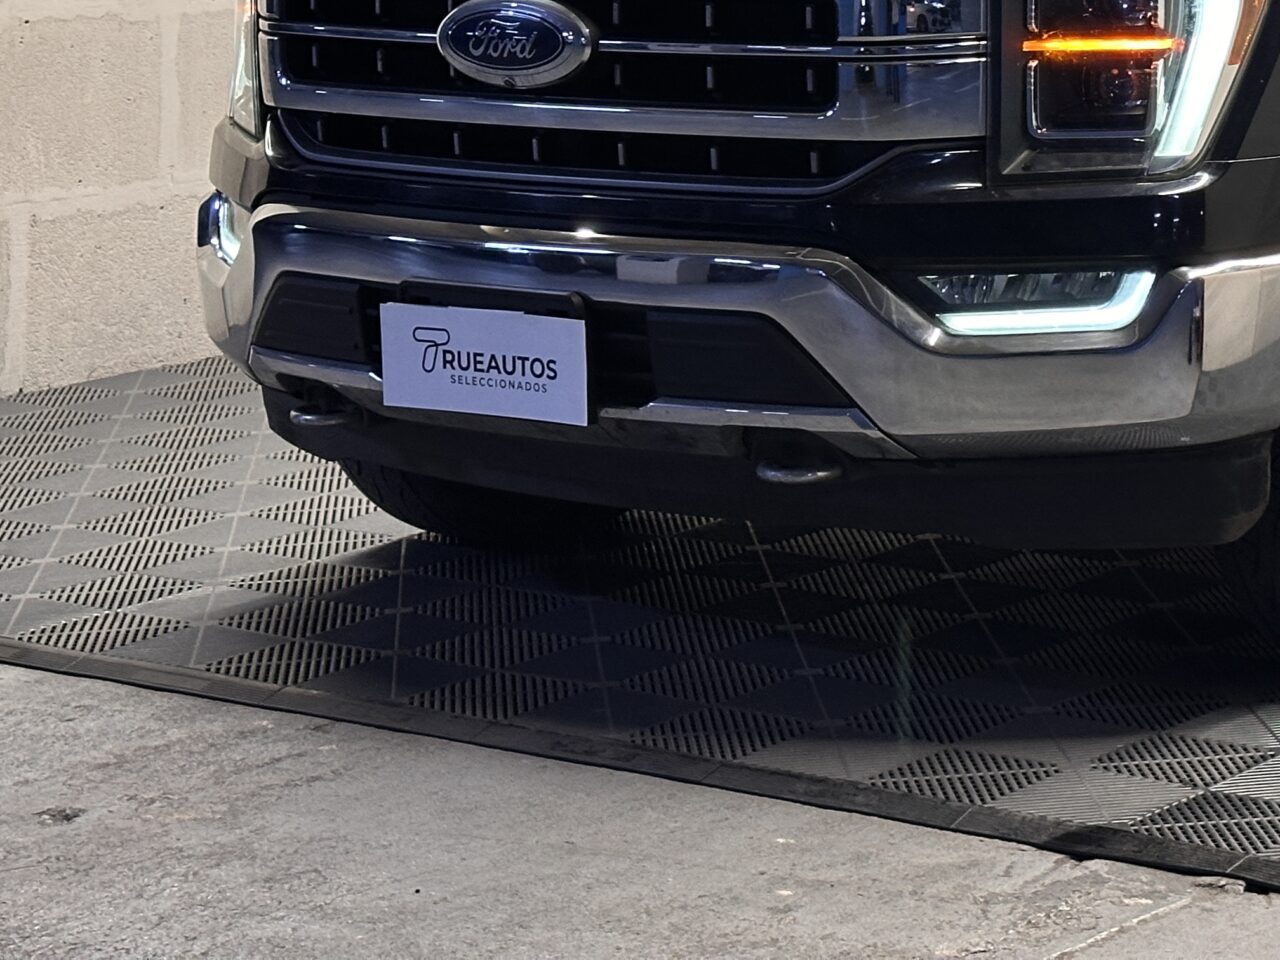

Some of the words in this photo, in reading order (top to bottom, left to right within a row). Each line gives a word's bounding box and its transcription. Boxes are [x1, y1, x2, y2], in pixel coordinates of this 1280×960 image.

[468, 19, 538, 58] Ford
[412, 326, 558, 381] TRUEAUTOS
[450, 374, 548, 394] SELECCIONADOS
